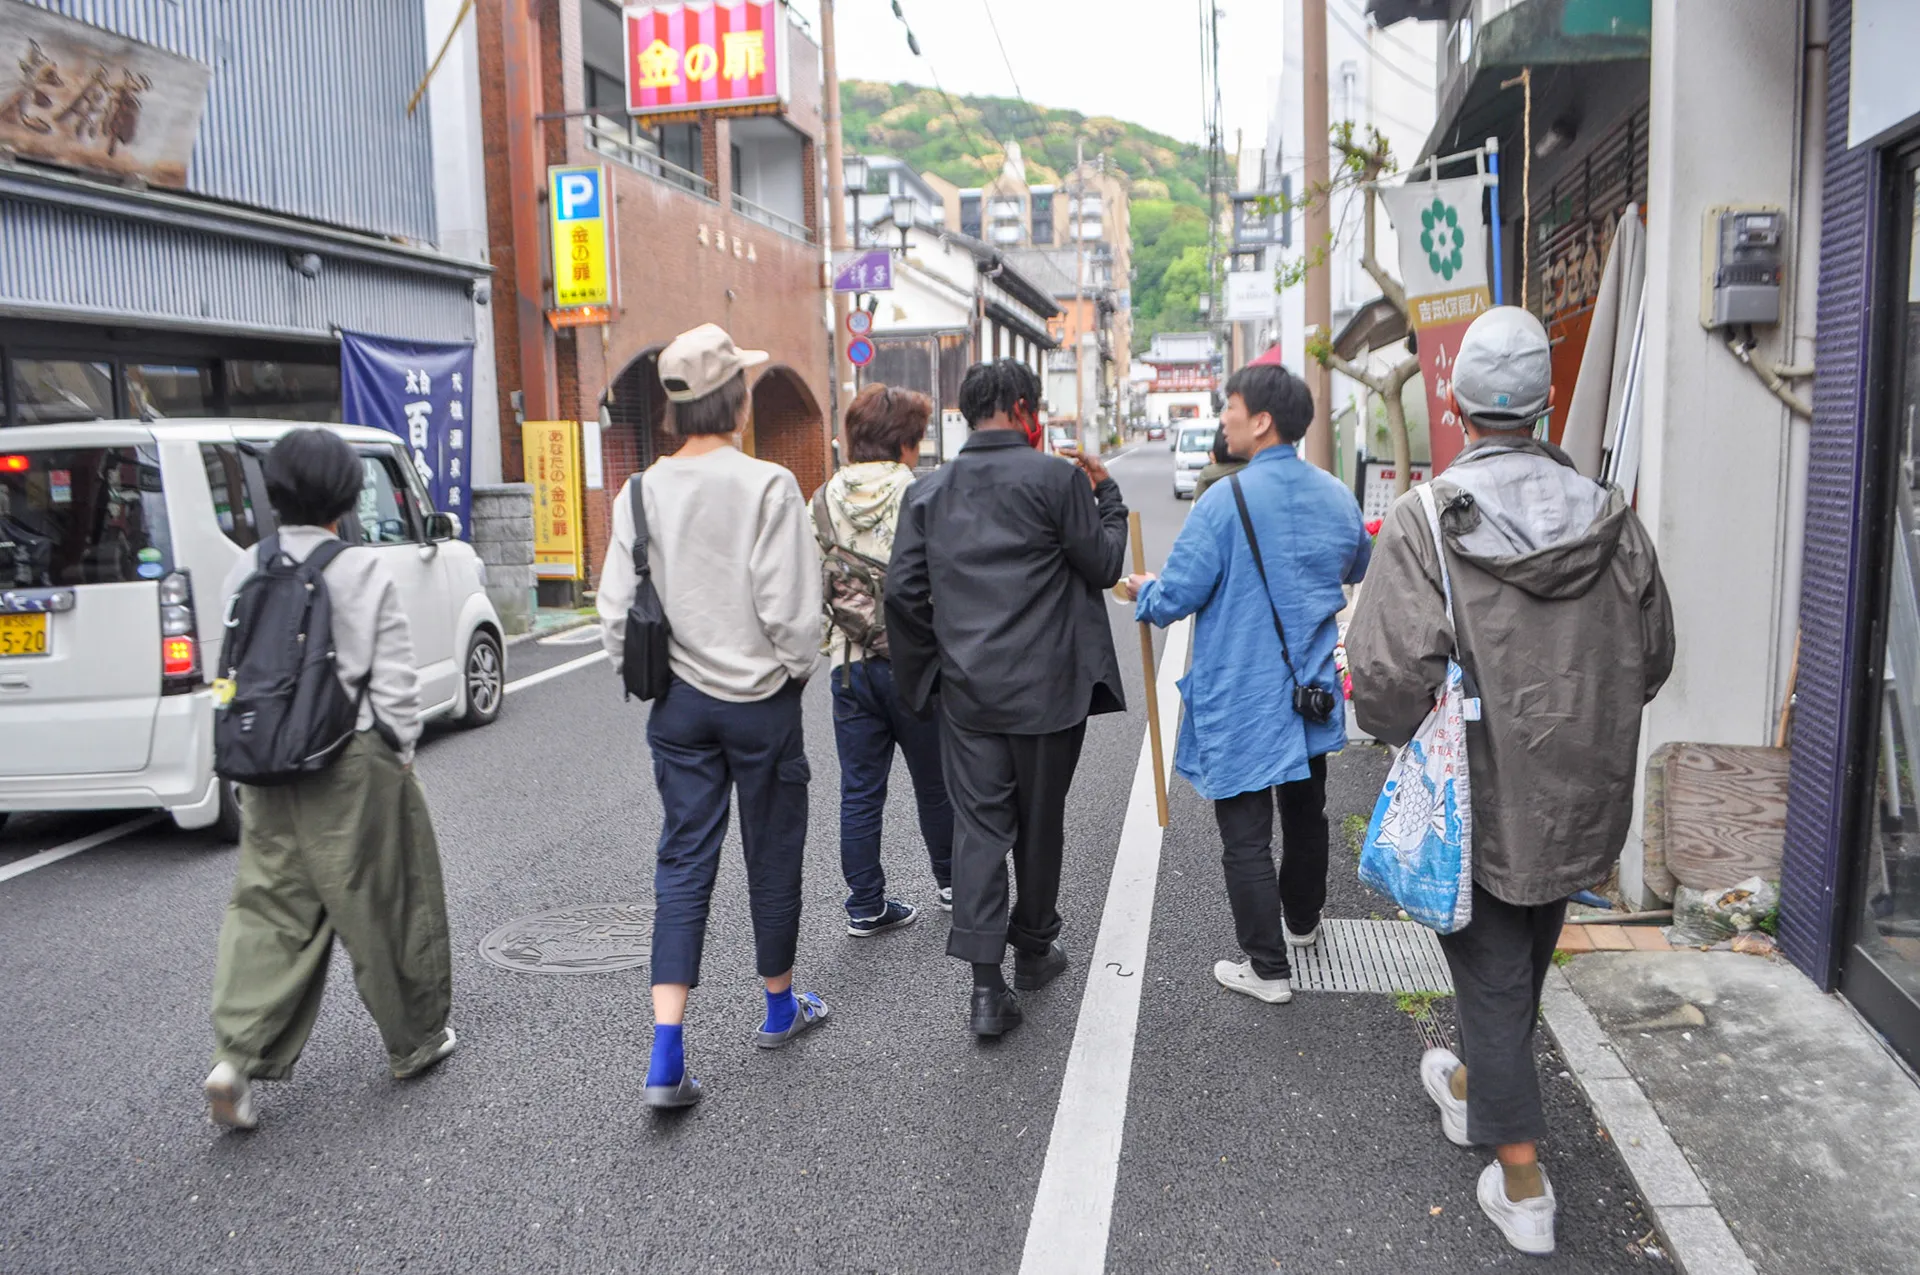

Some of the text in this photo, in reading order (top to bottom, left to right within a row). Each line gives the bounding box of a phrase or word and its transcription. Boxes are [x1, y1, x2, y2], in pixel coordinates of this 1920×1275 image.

[638, 30, 766, 89] 金の扉
[562, 175, 594, 219] P
[572, 226, 591, 281] 金の扉
[548, 430, 568, 537] あなたの金の扉
